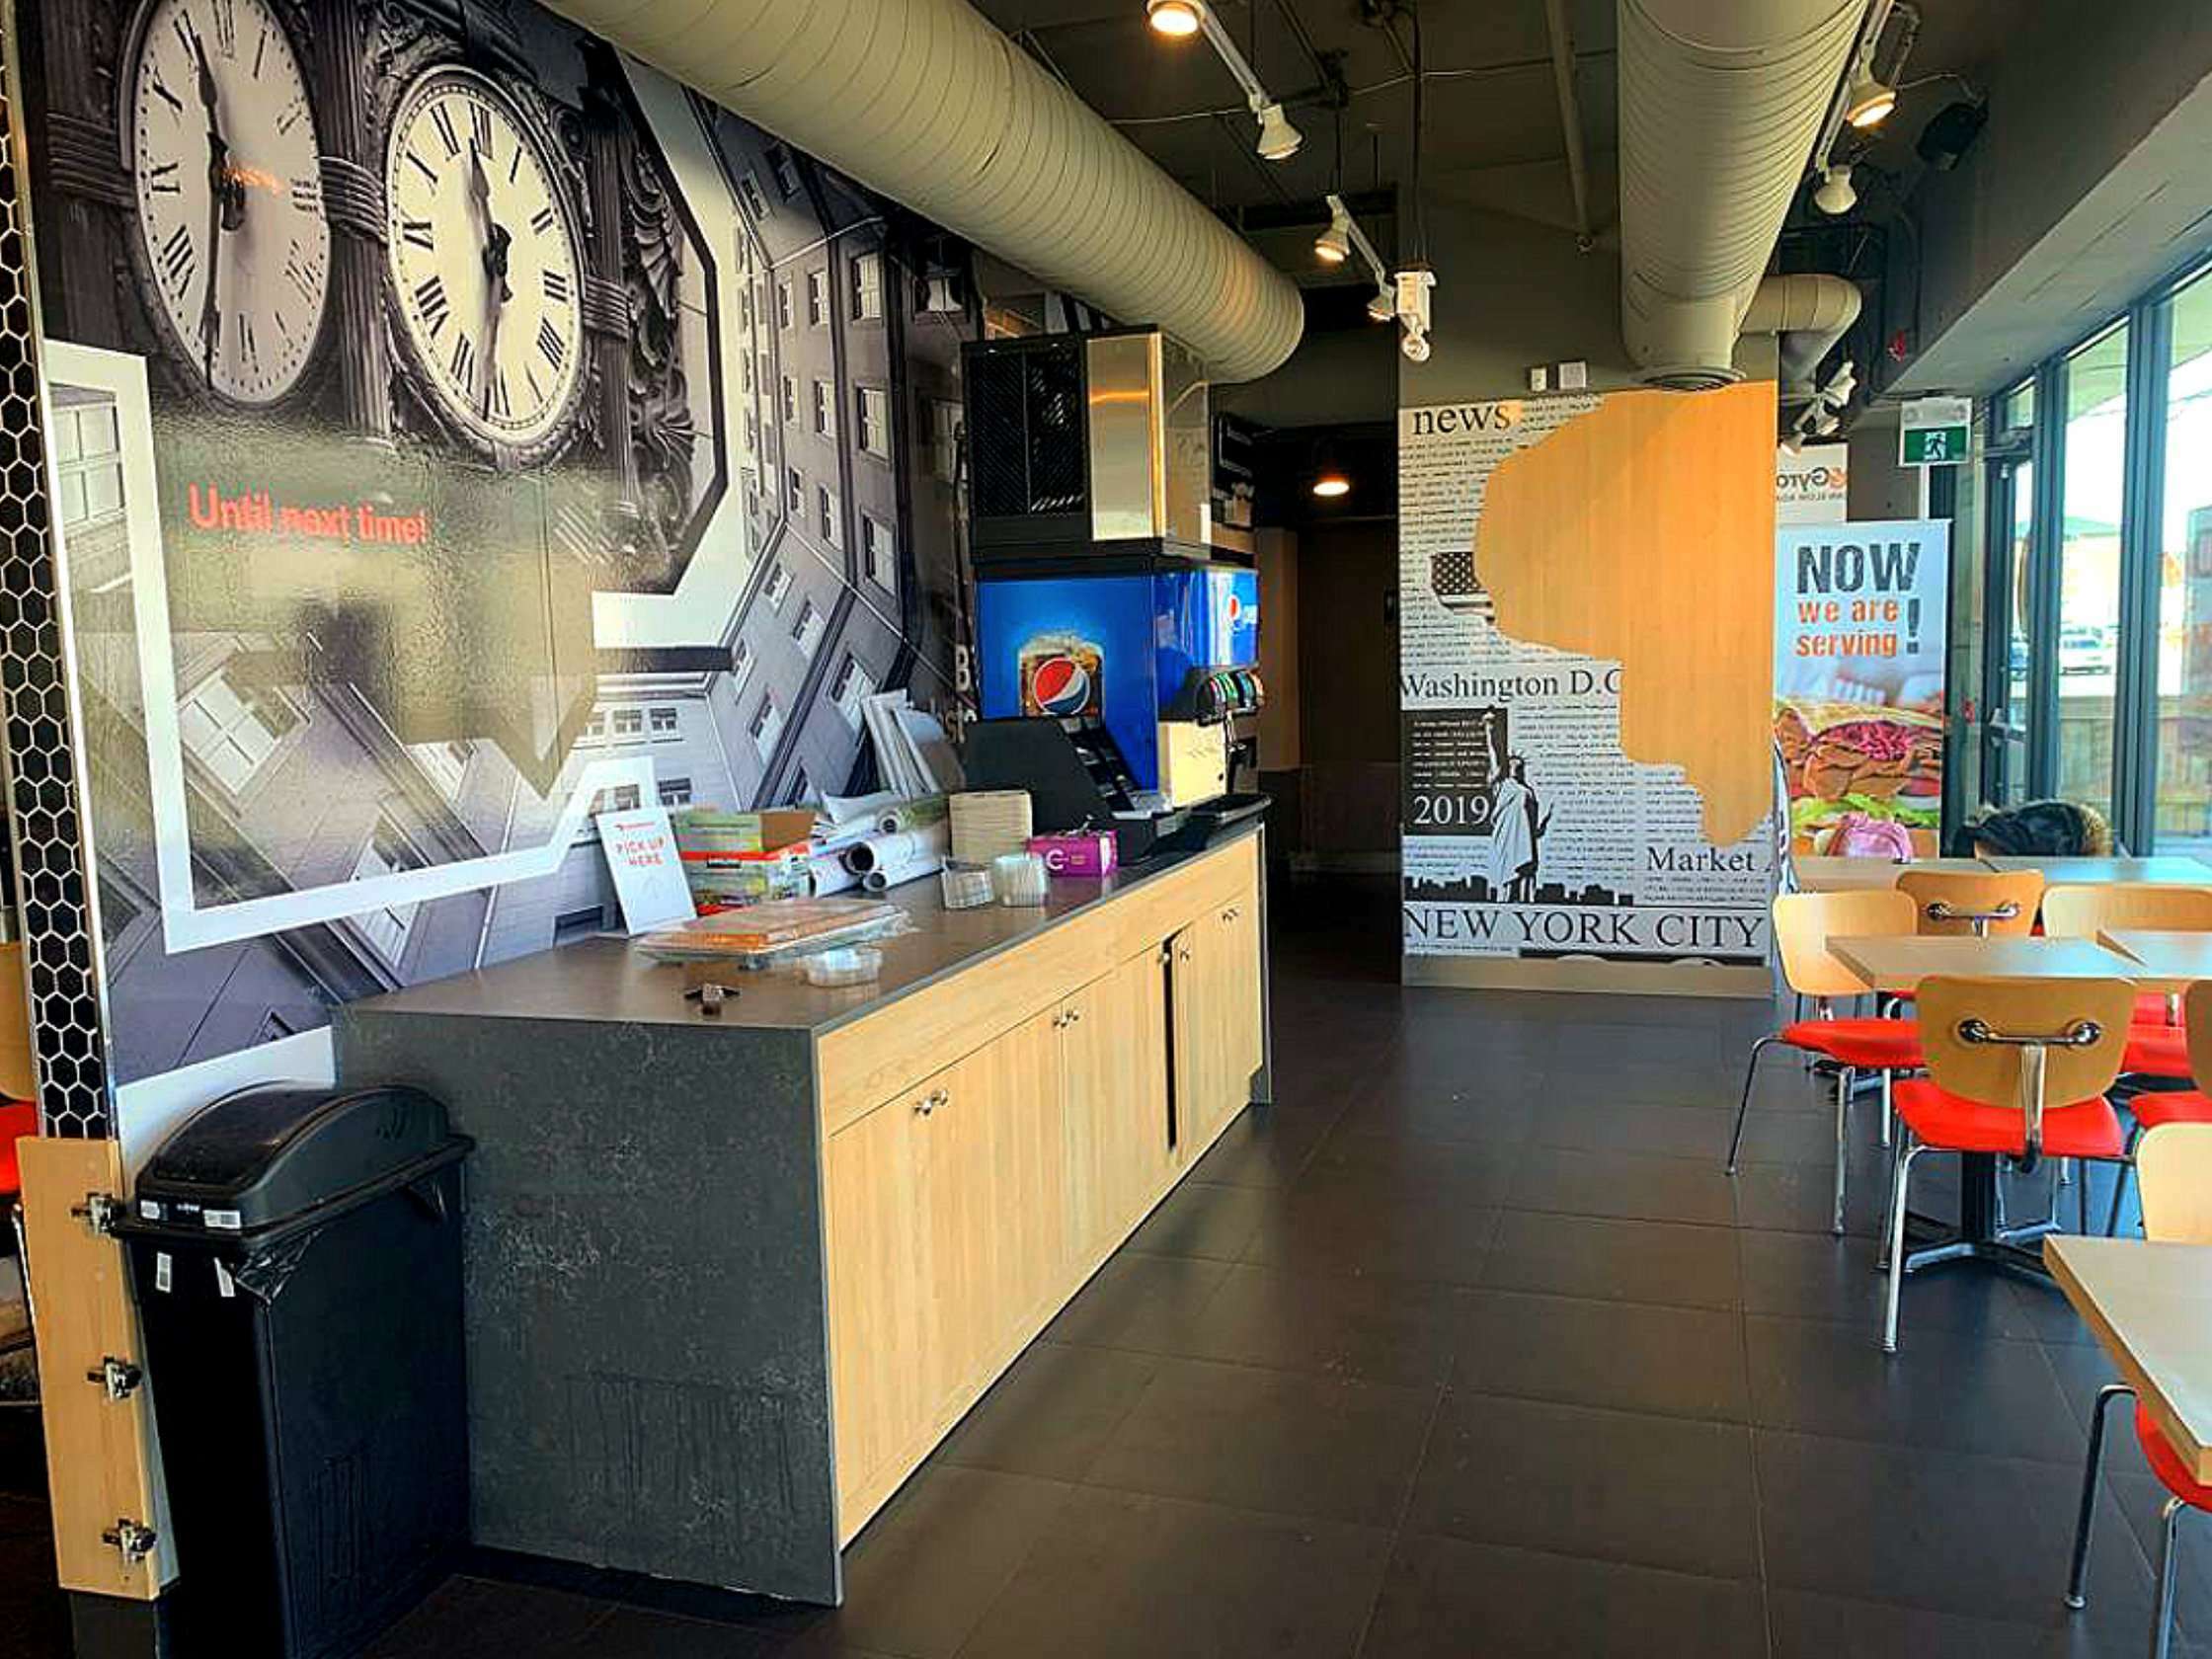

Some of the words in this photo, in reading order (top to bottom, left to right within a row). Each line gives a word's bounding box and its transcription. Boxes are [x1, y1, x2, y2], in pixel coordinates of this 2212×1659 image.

[1412, 404, 1511, 435] news
[189, 482, 272, 533] Until
[280, 505, 351, 537] next
[1796, 542, 1921, 593] NOW
[1798, 599, 1839, 623] we
[1852, 598, 1899, 622] are
[1795, 630, 1897, 658] serving
[1402, 671, 1558, 702] Washington
[1413, 795, 1490, 826] 2019
[1646, 846, 1755, 872] Market
[1402, 908, 1498, 939] NEW
[1517, 910, 1642, 945] YORK
[1656, 914, 1766, 949] CITY
